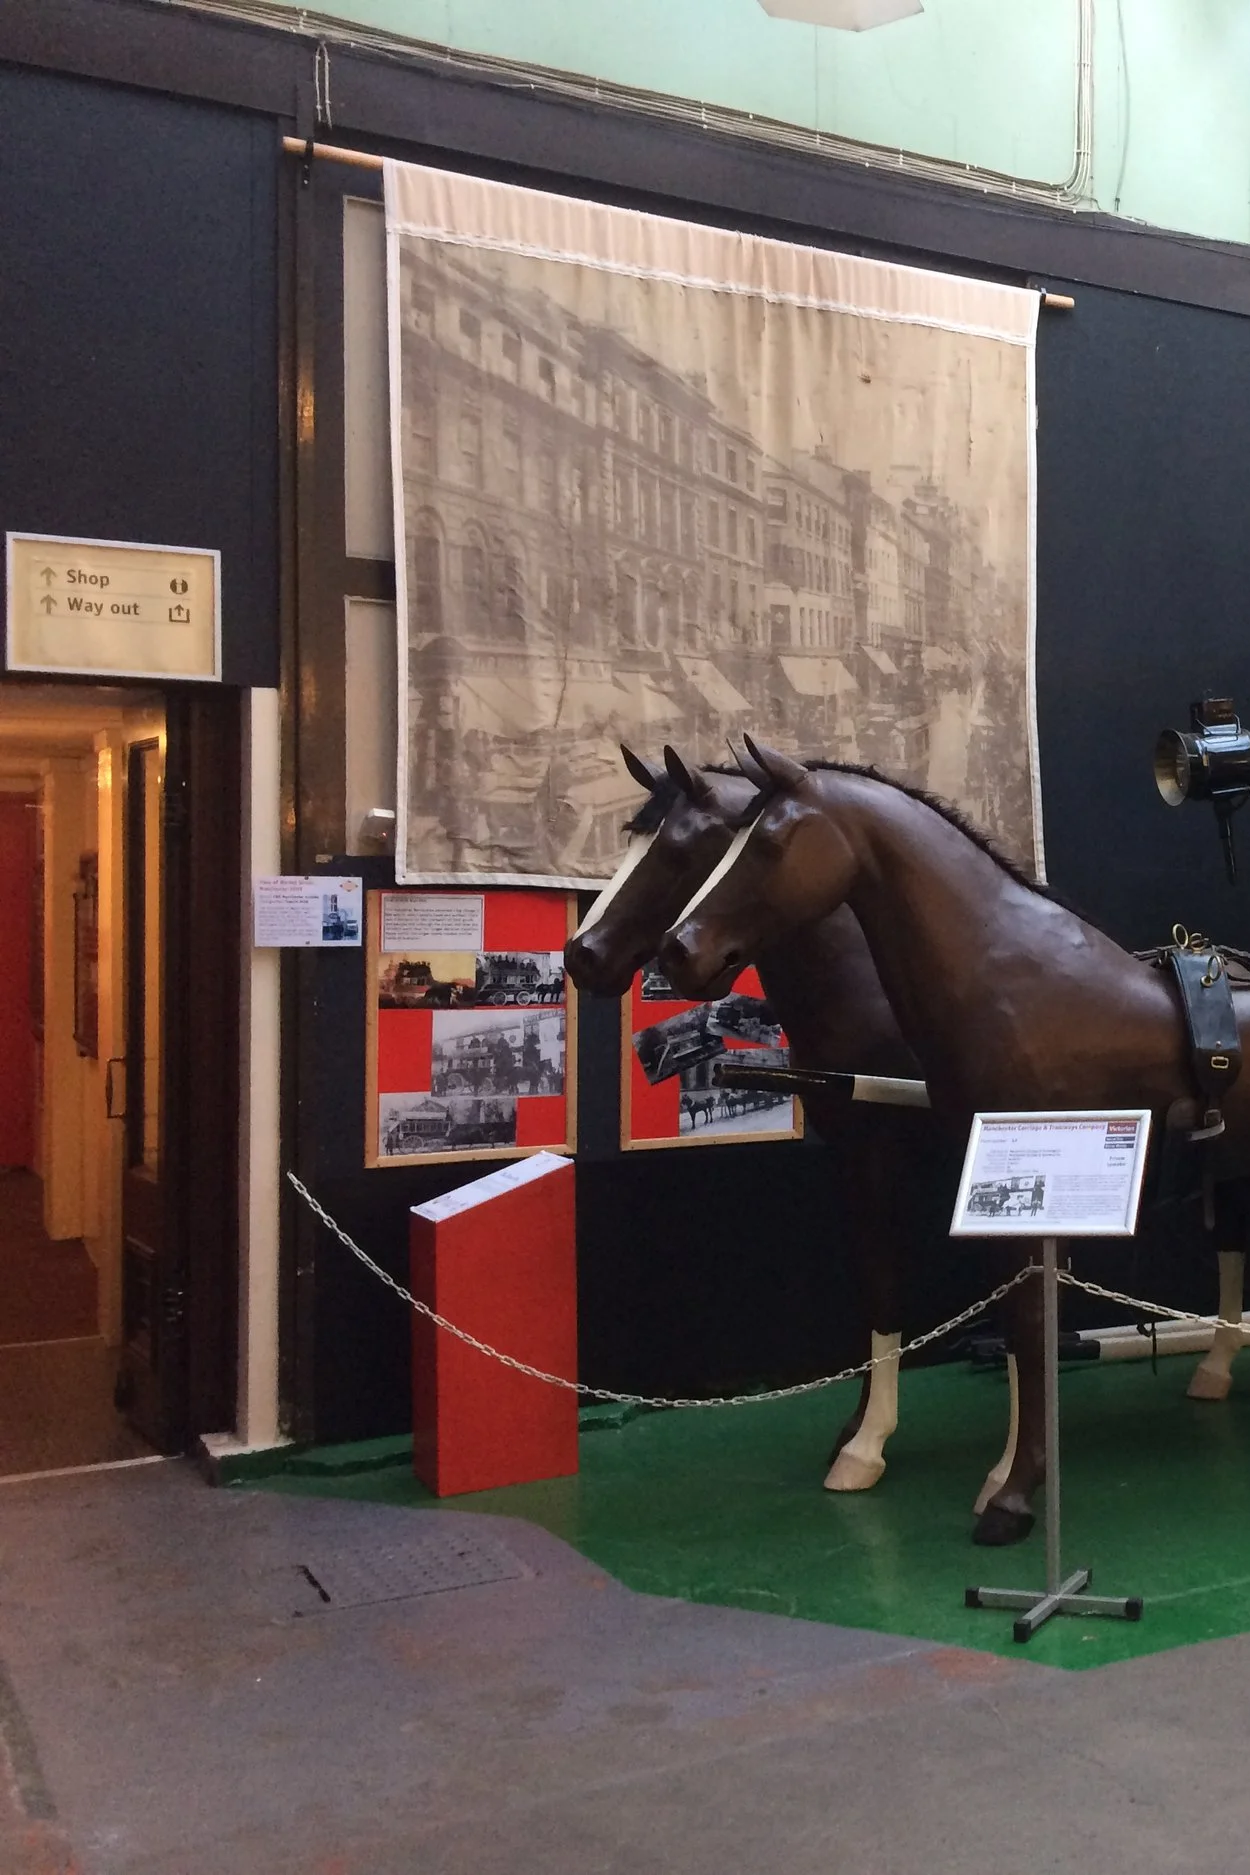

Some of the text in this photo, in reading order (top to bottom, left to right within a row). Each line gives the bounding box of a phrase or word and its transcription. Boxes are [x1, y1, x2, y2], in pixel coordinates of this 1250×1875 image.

[66, 569, 110, 589] Shop
[67, 597, 140, 616] Way out
